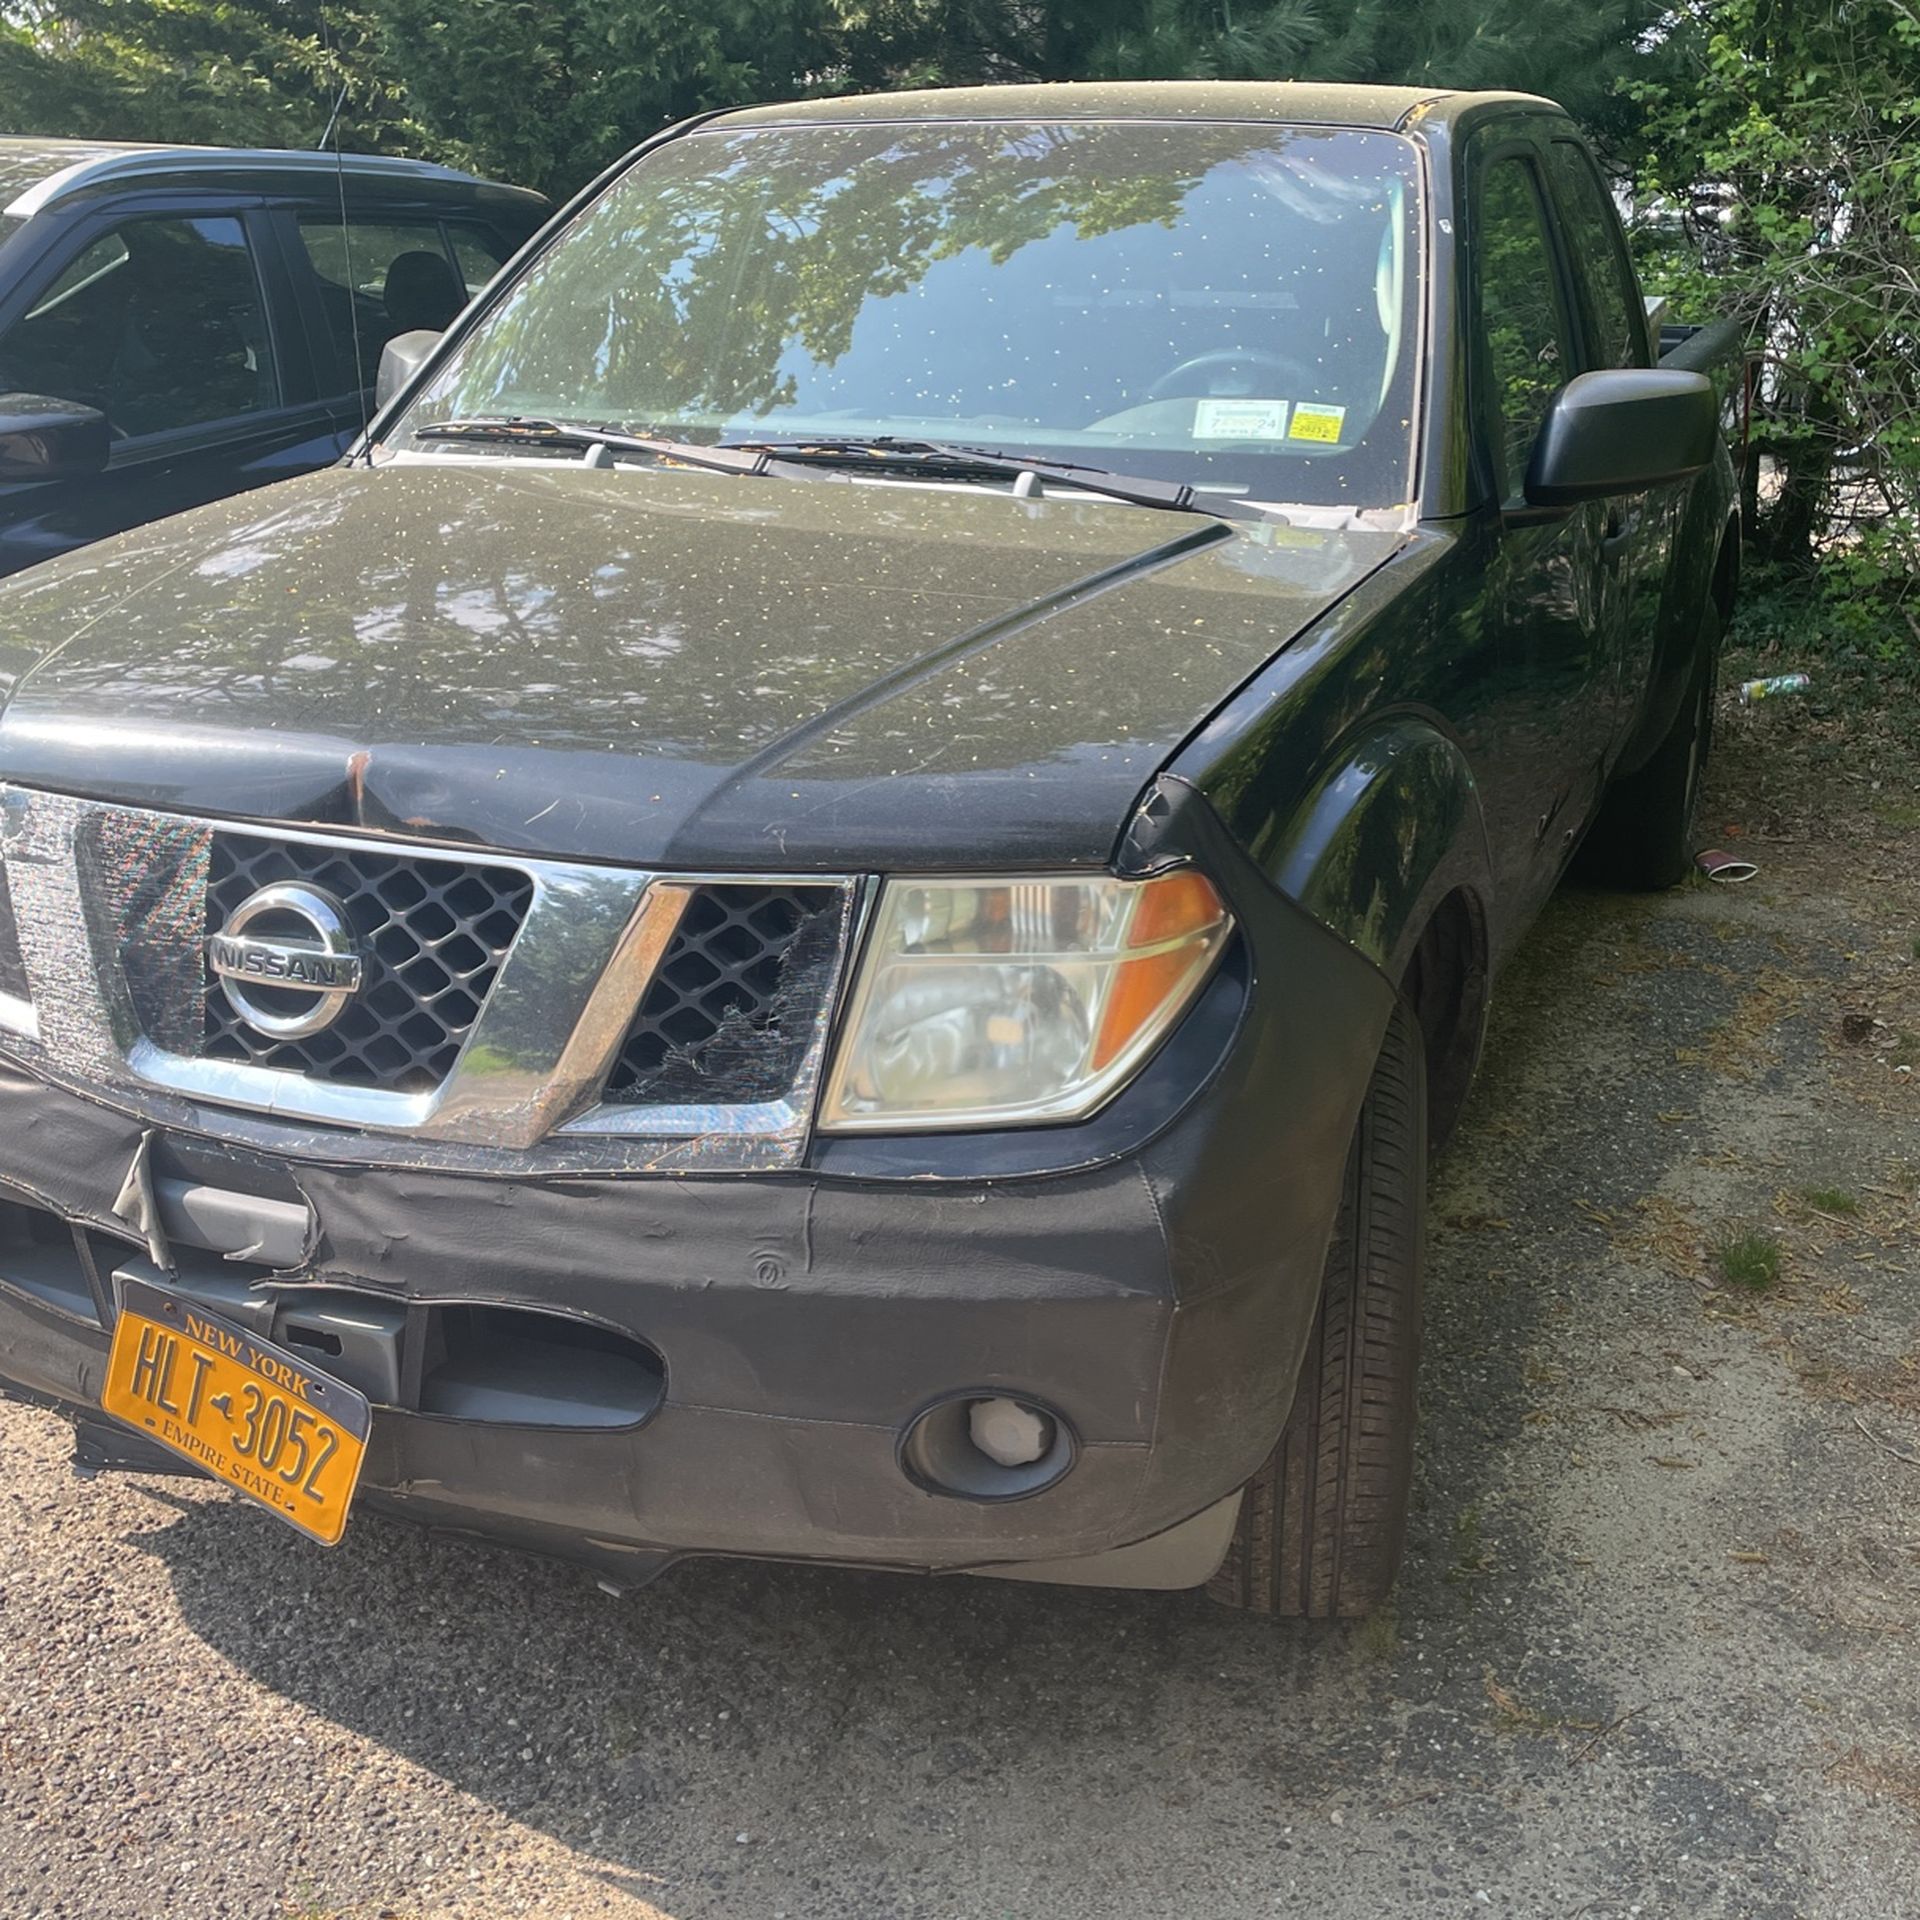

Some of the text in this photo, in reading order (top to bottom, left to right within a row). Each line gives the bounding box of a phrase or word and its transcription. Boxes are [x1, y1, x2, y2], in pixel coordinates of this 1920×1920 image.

[1257, 418, 1276, 429] 24
[214, 942, 338, 985] NISSAN
[184, 1314, 311, 1399] NEW YORK
[130, 1322, 340, 1505] HLT 3052
[162, 1419, 284, 1503] EMPIRE STATE
